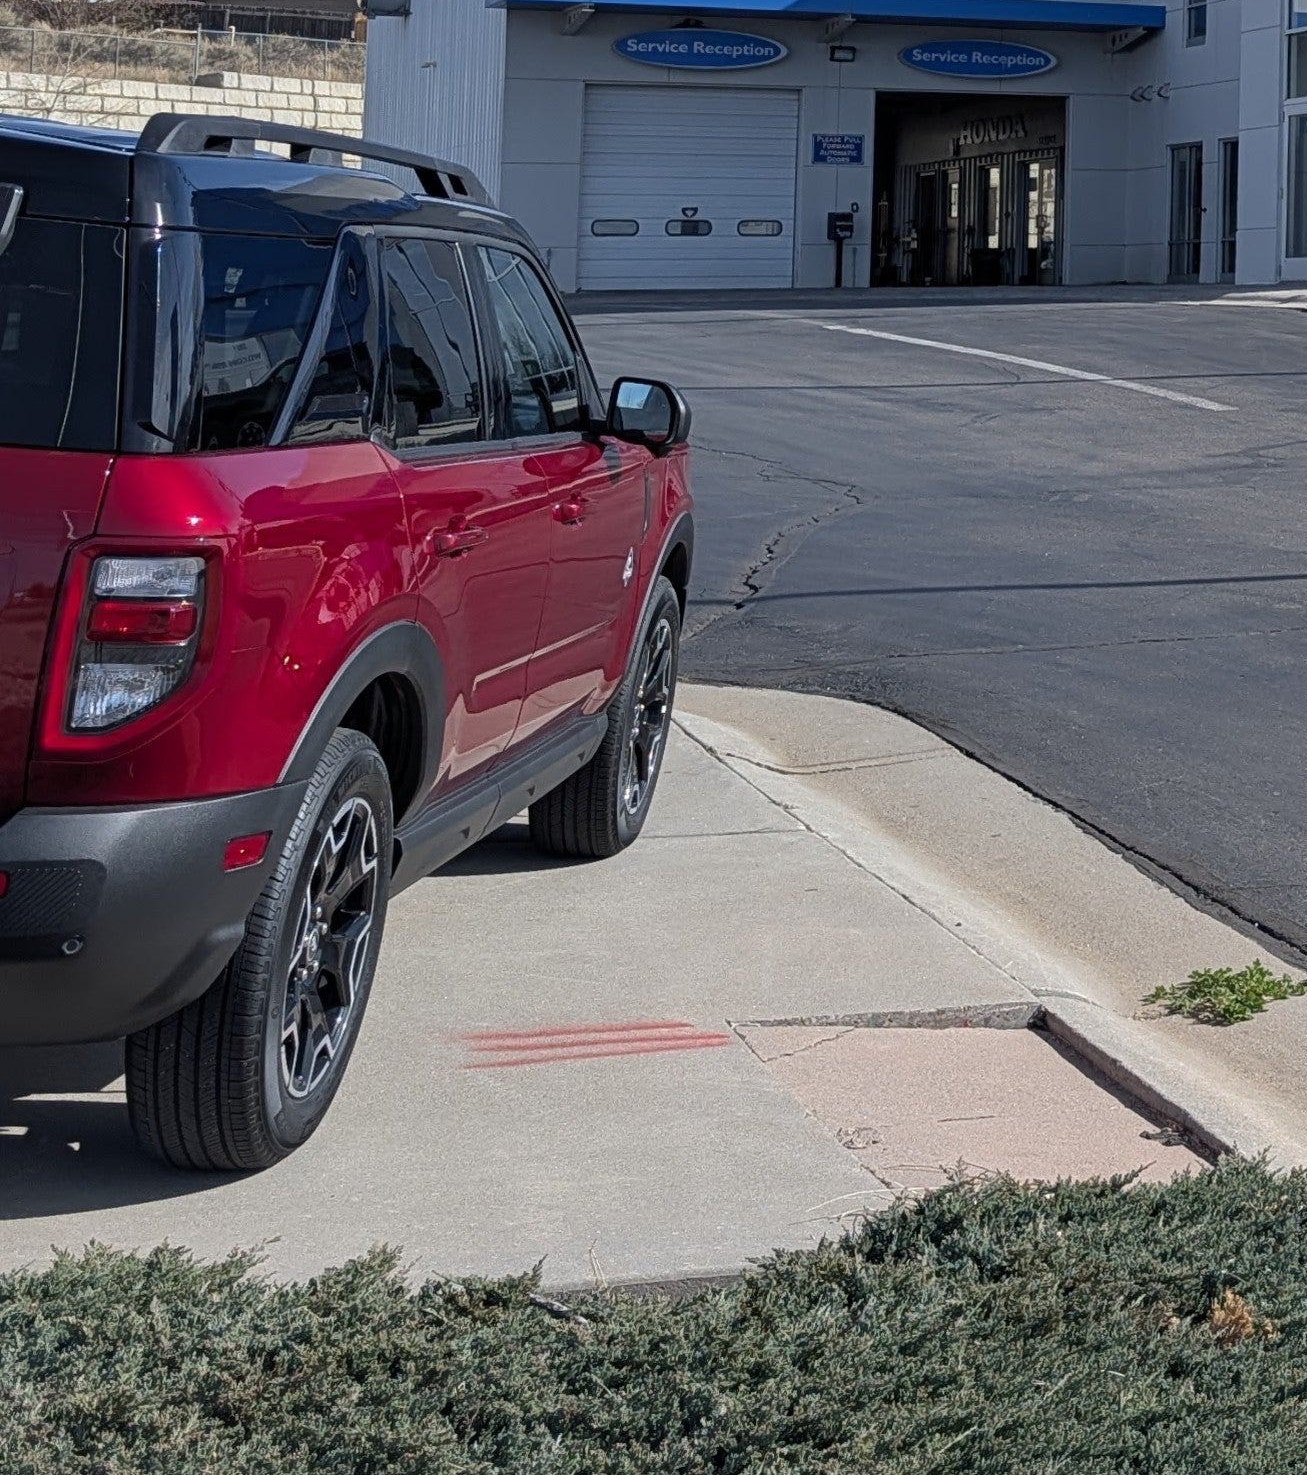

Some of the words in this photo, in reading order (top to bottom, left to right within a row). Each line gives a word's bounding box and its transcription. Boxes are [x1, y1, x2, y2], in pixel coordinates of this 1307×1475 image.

[626, 39, 688, 53] Service
[693, 41, 774, 58] Reception
[912, 49, 967, 63] Service
[972, 51, 1045, 67] Reception
[959, 114, 1027, 145] HONDA
